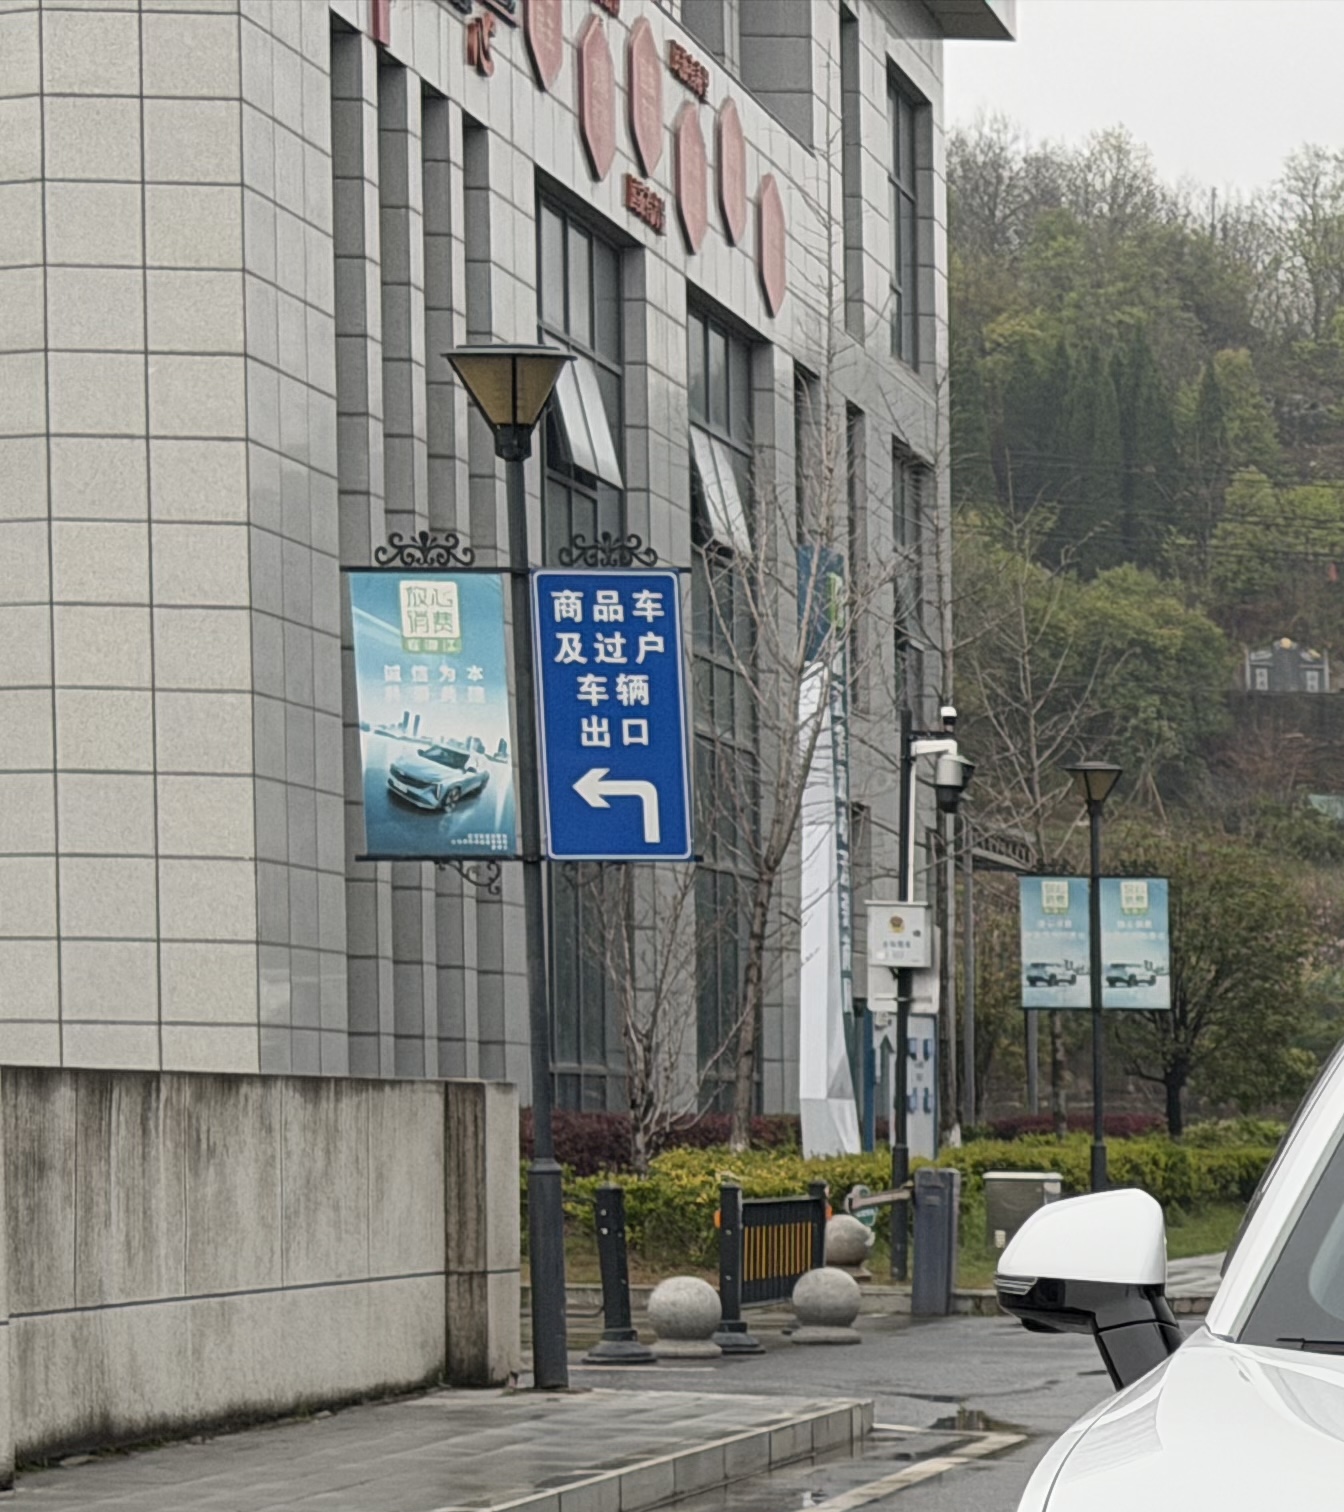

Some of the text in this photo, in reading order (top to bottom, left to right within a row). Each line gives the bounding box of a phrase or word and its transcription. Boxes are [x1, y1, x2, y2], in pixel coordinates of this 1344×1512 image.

[551, 590, 665, 623] 商品车
[555, 632, 665, 665] 及过户
[577, 674, 651, 707] 车辆
[581, 715, 650, 749] 出口
